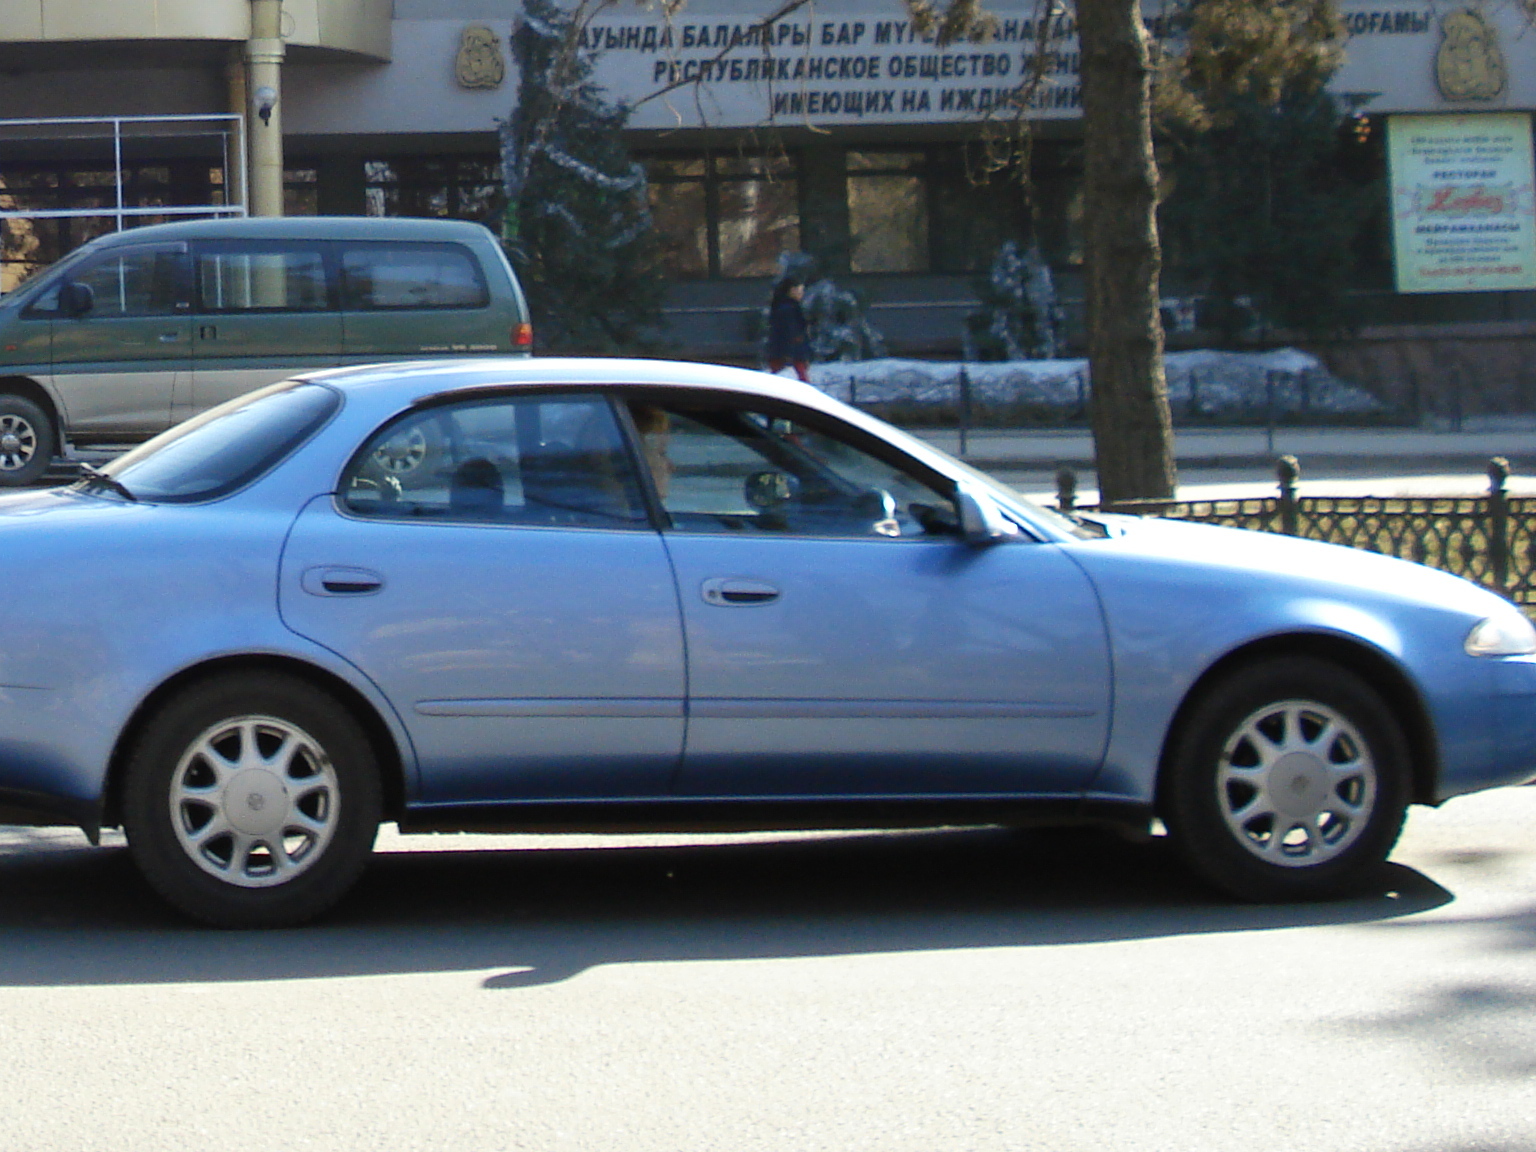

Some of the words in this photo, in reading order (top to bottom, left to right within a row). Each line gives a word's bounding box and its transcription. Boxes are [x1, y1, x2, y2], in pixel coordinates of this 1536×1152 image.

[681, 22, 812, 48] БАЛАЛАРЫ
[820, 21, 866, 46] БАР
[652, 55, 881, 83] РЕСПУБЛИКАНСКОЕ
[887, 52, 1012, 80] ОБЩЕСТВО
[773, 89, 895, 116] ИМЕЮЩИХ
[900, 89, 931, 112] НА
